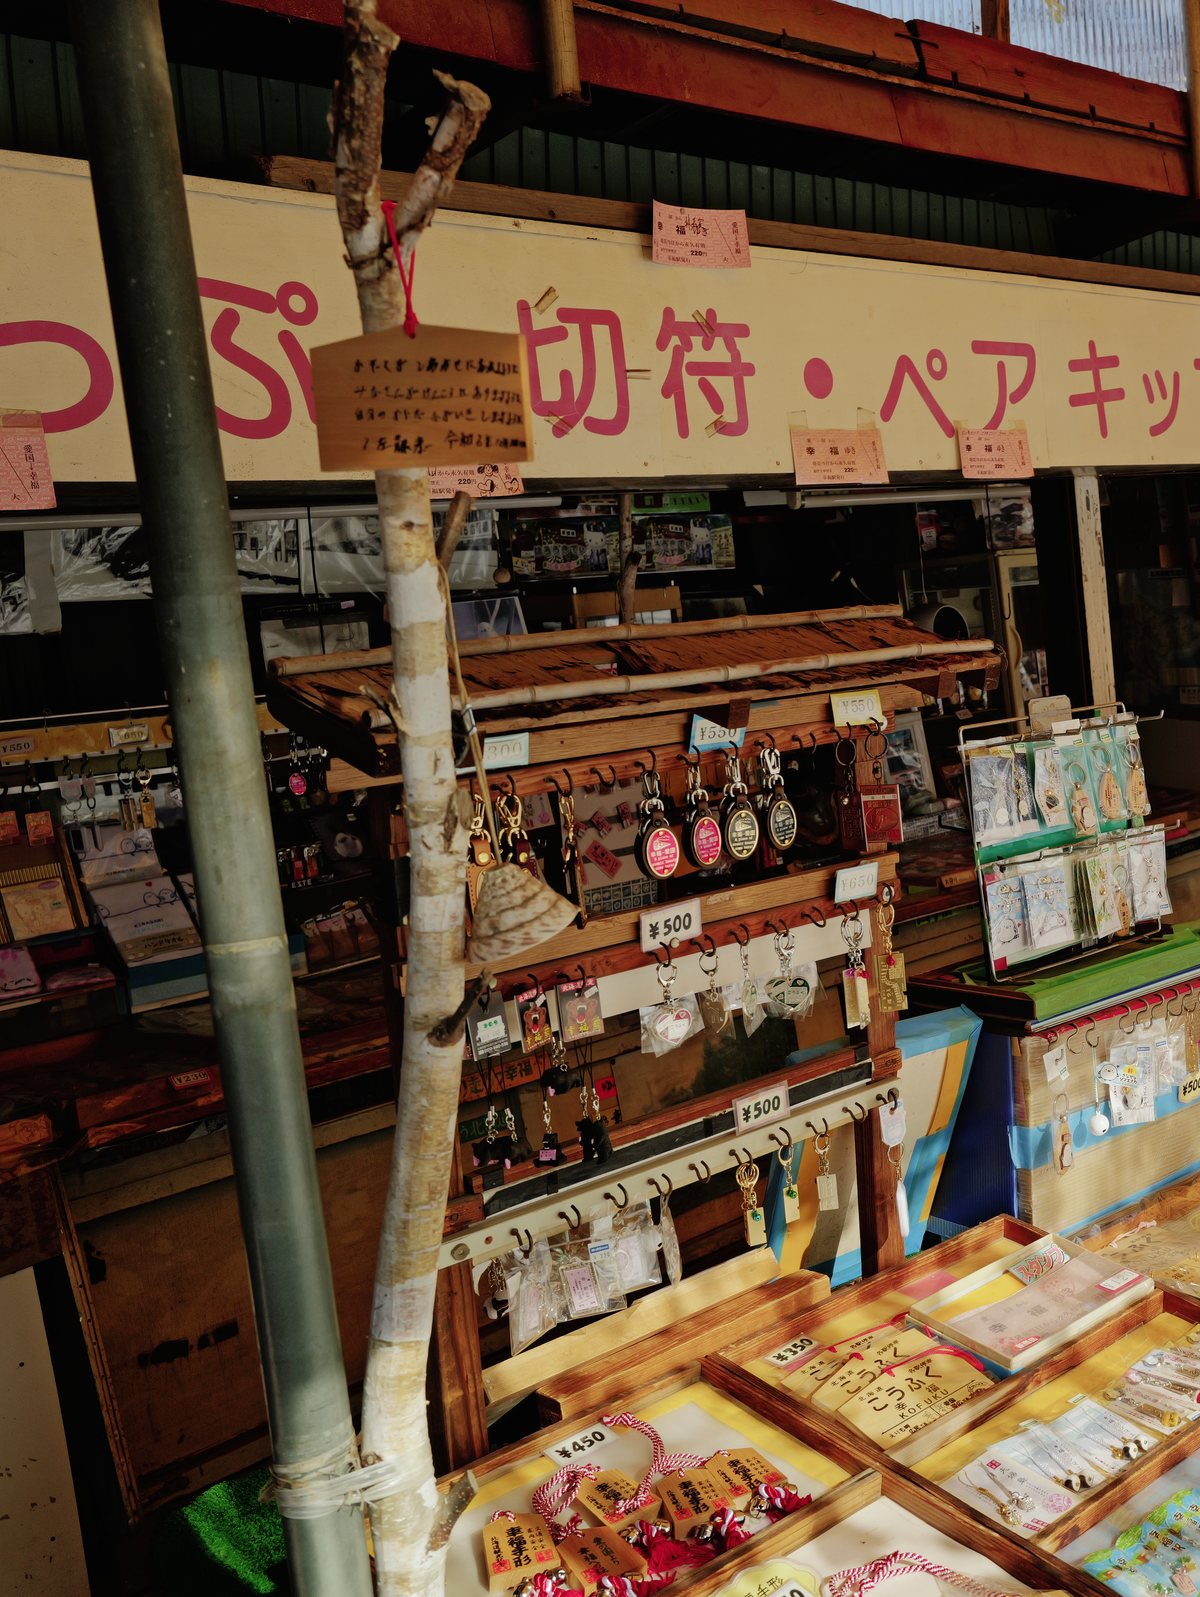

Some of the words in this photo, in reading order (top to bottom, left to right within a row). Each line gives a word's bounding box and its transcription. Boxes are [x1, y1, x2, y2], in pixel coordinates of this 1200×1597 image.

[841, 699, 875, 715] ¥550
[699, 726, 738, 741] ¥550
[2, 742, 31, 753] ¥550
[841, 873, 875, 892] ¥650
[648, 912, 692, 940] ¥500
[175, 1071, 207, 1084] ¥230
[742, 1095, 781, 1123] ¥500
[772, 1337, 814, 1363] ¥350
[868, 1365, 943, 1412] こうふく
[898, 1388, 949, 1420] KOFUKU
[555, 1430, 606, 1459] ¥450
[505, 1525, 532, 1568] 幸福手形
